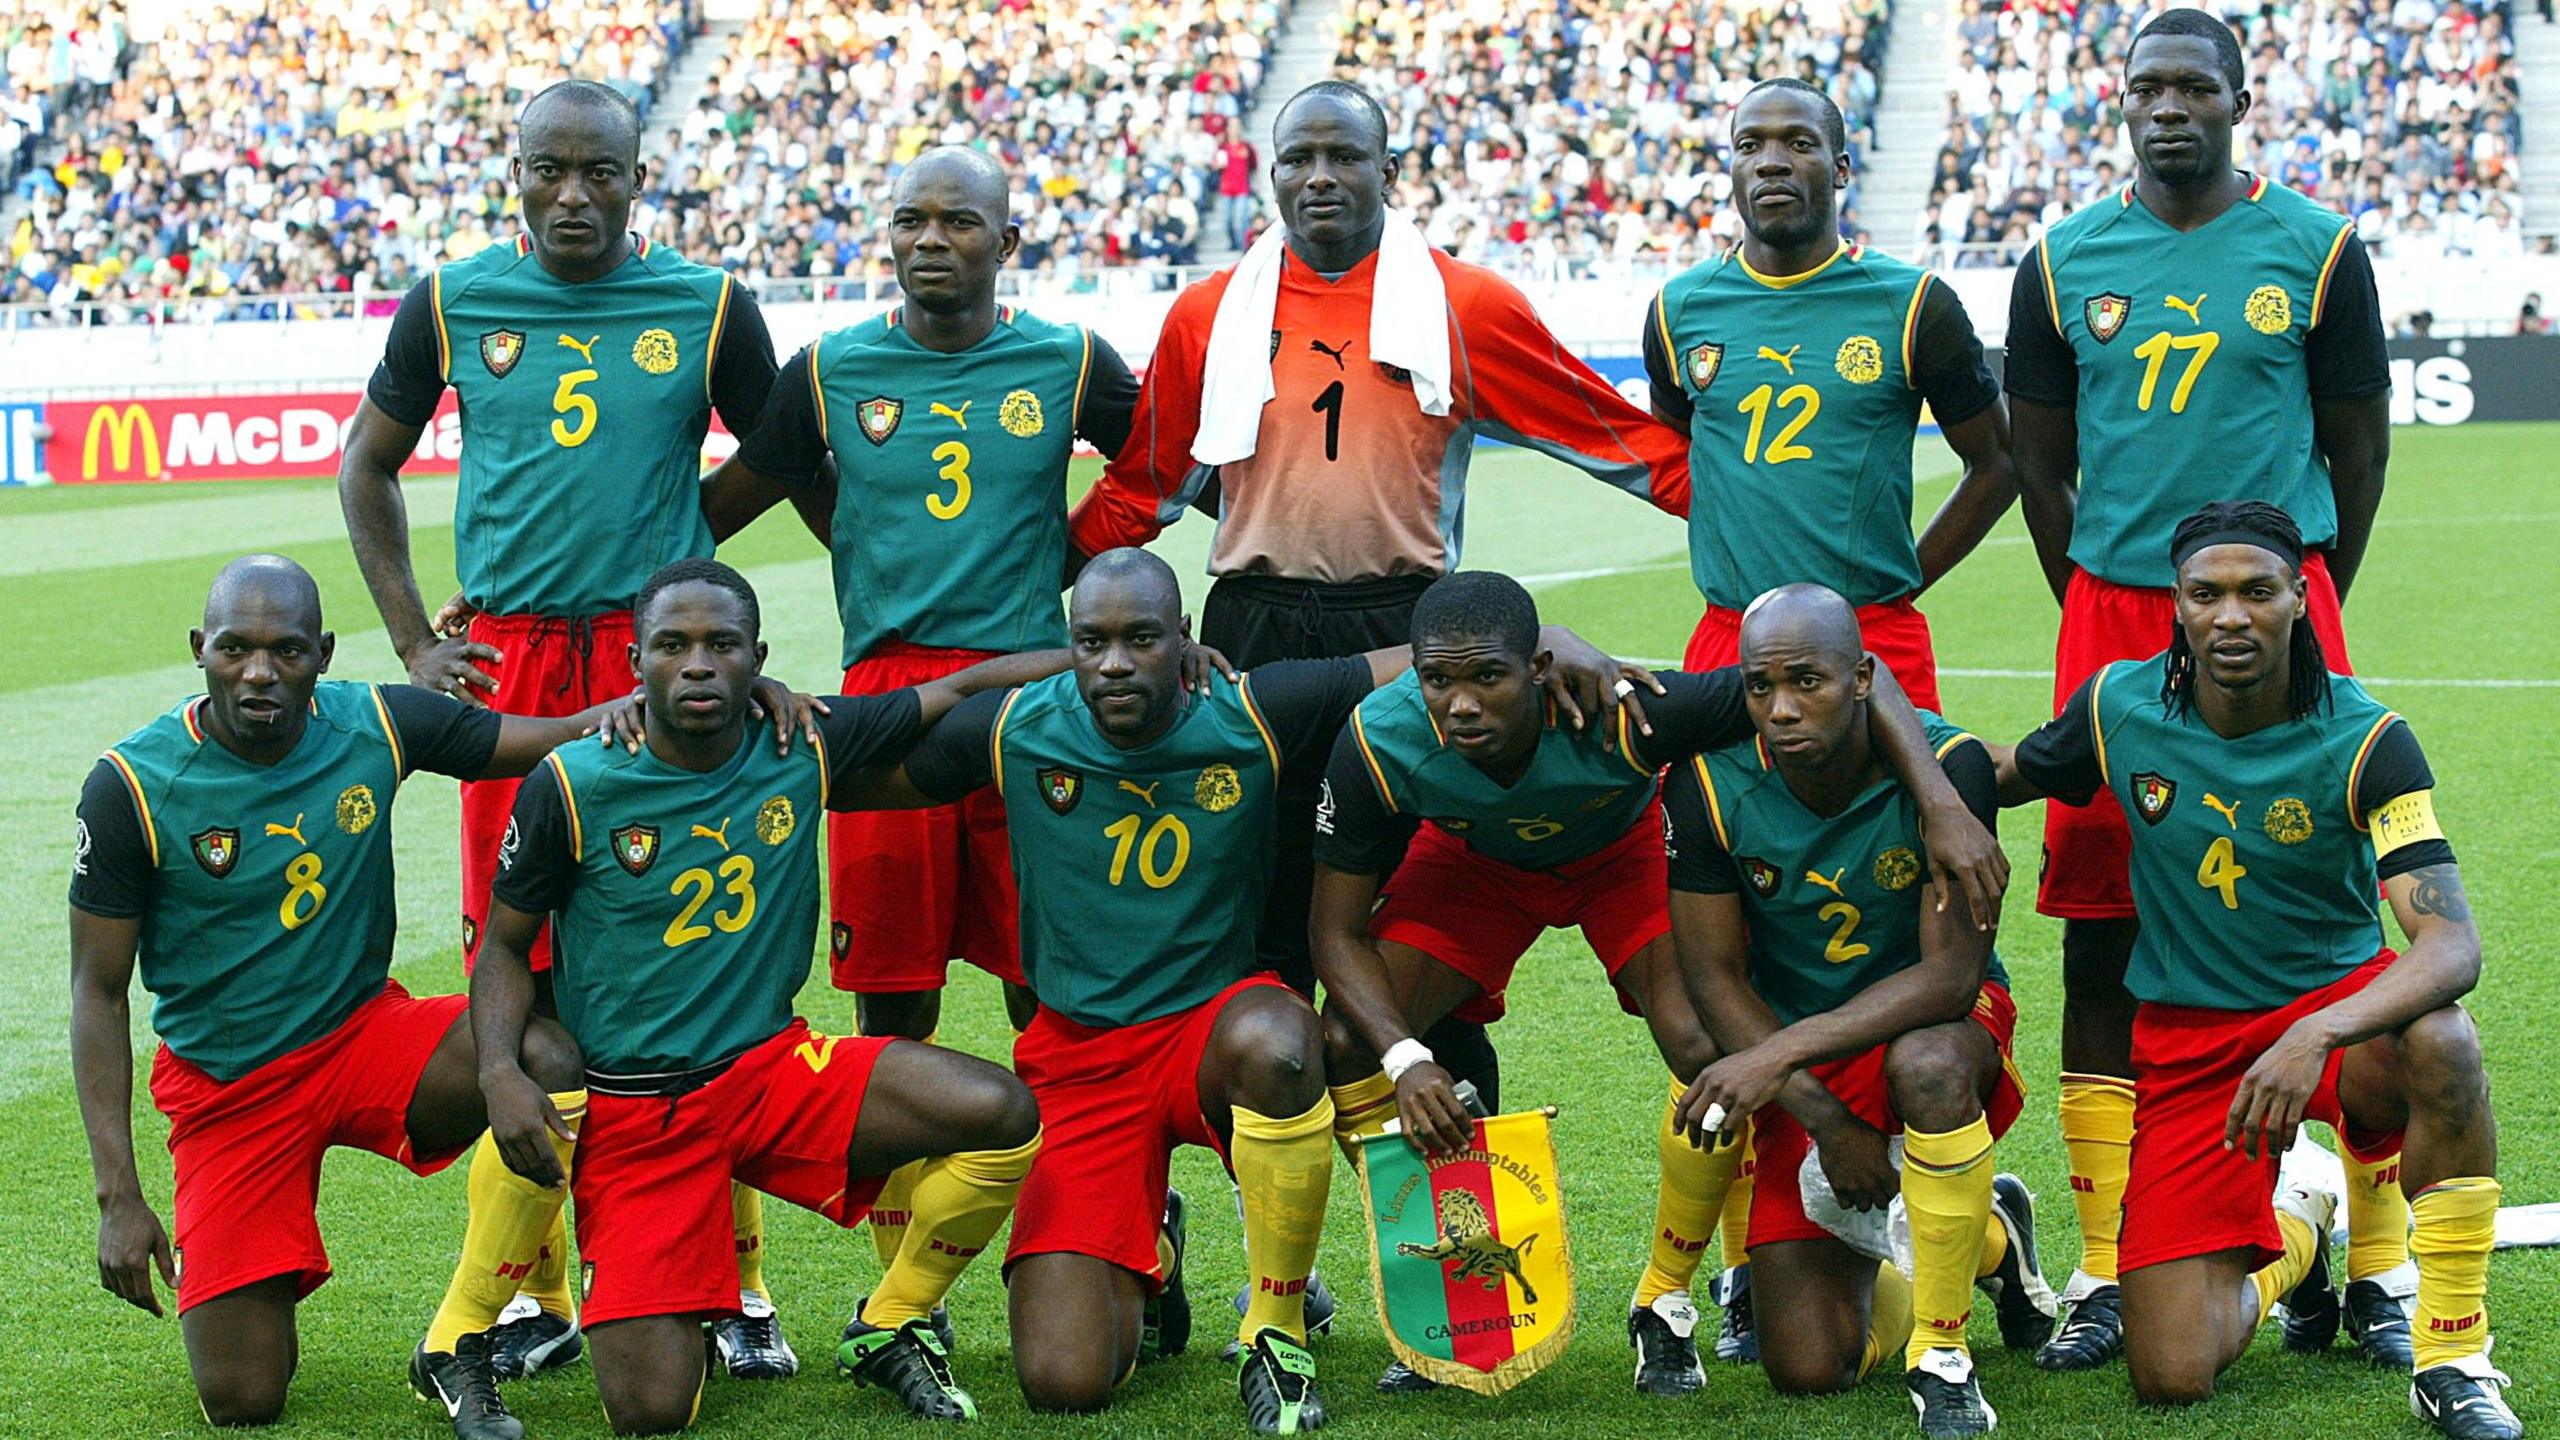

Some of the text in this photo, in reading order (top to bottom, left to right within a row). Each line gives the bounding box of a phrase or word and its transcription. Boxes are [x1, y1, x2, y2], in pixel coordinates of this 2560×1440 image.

[551, 368, 599, 447] 5
[2134, 330, 2220, 414] 17
[1311, 380, 1345, 462] 1
[1737, 384, 1821, 464] 12
[926, 441, 972, 520] 3
[1103, 814, 1191, 889] 10
[2197, 836, 2248, 911] 4
[279, 852, 328, 931] 8
[663, 854, 757, 948] 23
[1818, 902, 1871, 964] 2
[1382, 1149, 1550, 1225] Lions Indomptables
[1424, 1312, 1537, 1341] CAMEROUN
[2430, 1311, 2481, 1332] PUMA
